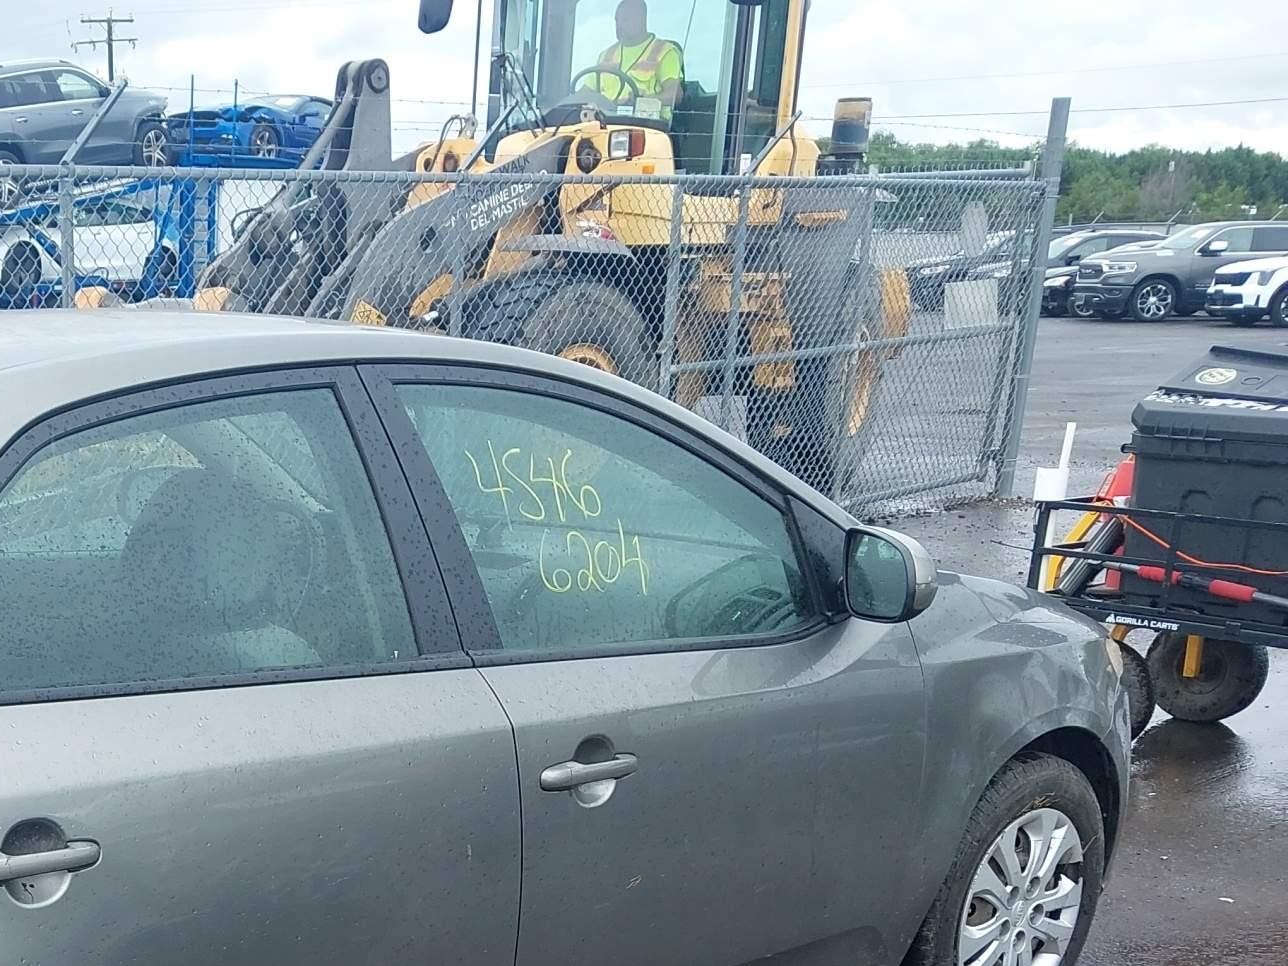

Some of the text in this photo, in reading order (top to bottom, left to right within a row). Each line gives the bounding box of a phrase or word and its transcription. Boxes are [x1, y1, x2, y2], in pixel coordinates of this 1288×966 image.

[470, 215, 491, 231] DEL
[464, 440, 601, 531] 4546
[540, 518, 648, 595] 6204
[1115, 615, 1179, 631] GORILLA CARTS
